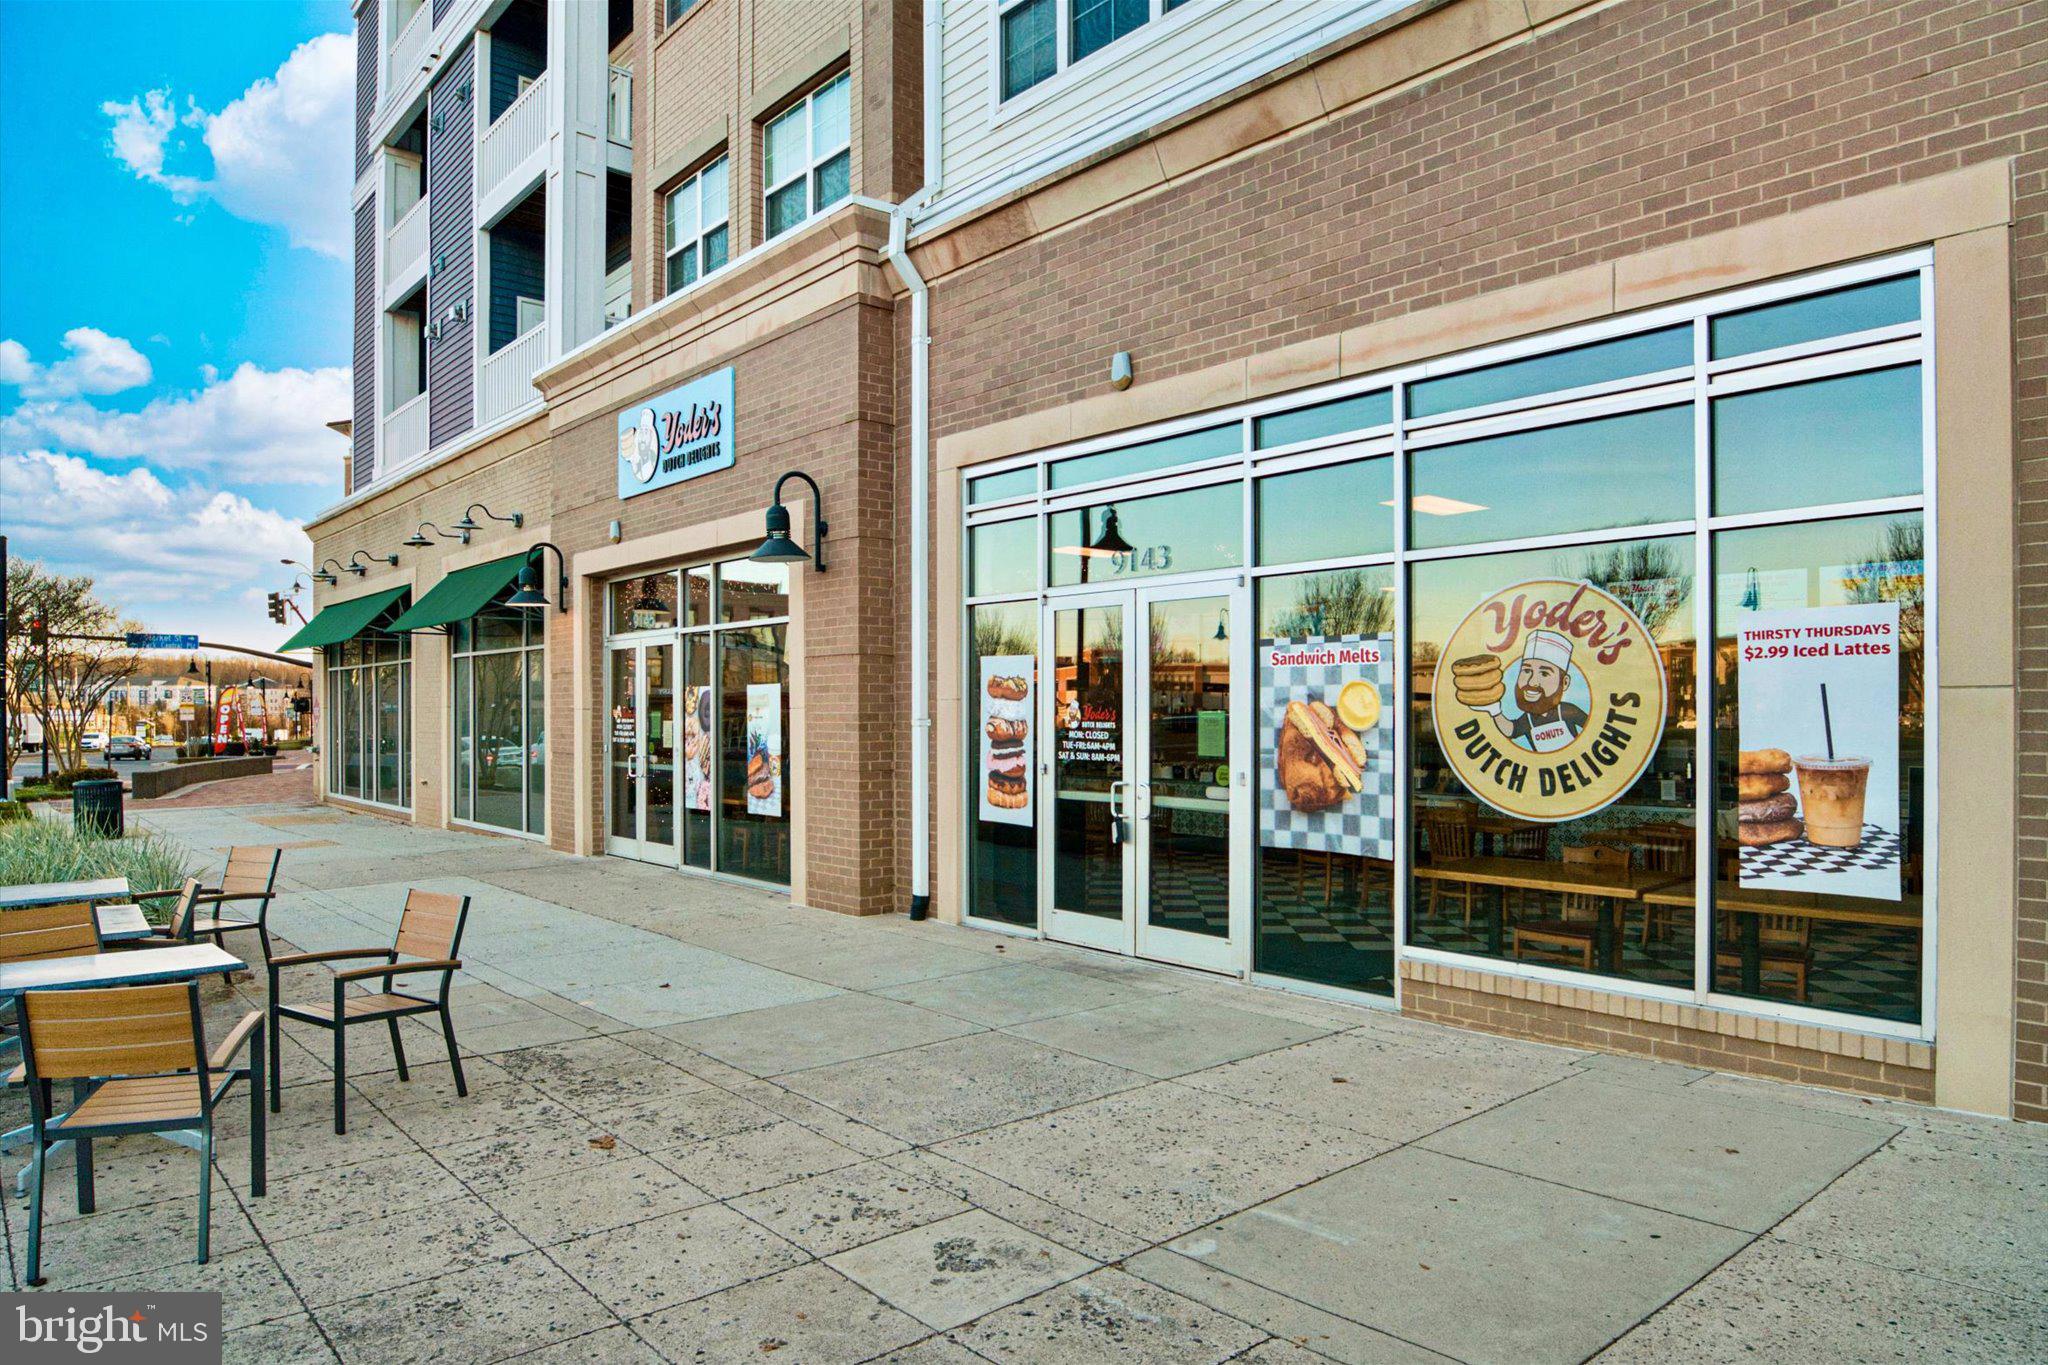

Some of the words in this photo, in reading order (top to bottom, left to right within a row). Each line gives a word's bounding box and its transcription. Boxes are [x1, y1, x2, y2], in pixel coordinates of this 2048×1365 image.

[661, 400, 721, 454] Yoder's
[662, 454, 686, 473] DUTCH
[687, 442, 721, 466] DELIGHTS
[1111, 545, 1173, 574] 9143
[1483, 583, 1632, 665] Yoder's
[1744, 628, 1801, 641] THIRSTY
[1805, 624, 1891, 637] THURSDAYS
[1272, 649, 1335, 666] Sandwich
[1339, 648, 1380, 663] Melts
[1744, 646, 1789, 662] $2.99
[1794, 643, 1829, 657] Iced
[1834, 642, 1891, 656] Lattes
[1082, 703, 1116, 721] Yoder's
[217, 704, 230, 744] OPEN
[1534, 727, 1565, 741] DONUTS
[1068, 731, 1084, 739] MON:
[1085, 731, 1110, 740] CLOSED
[1454, 718, 1528, 793] DUTCH
[1538, 691, 1641, 797] DELIGHTS
[1058, 751, 1069, 760] SAT
[1070, 752, 1076, 760] &
[1076, 752, 1090, 761] SUN:
[1091, 752, 1121, 763] 8AM-6PM
